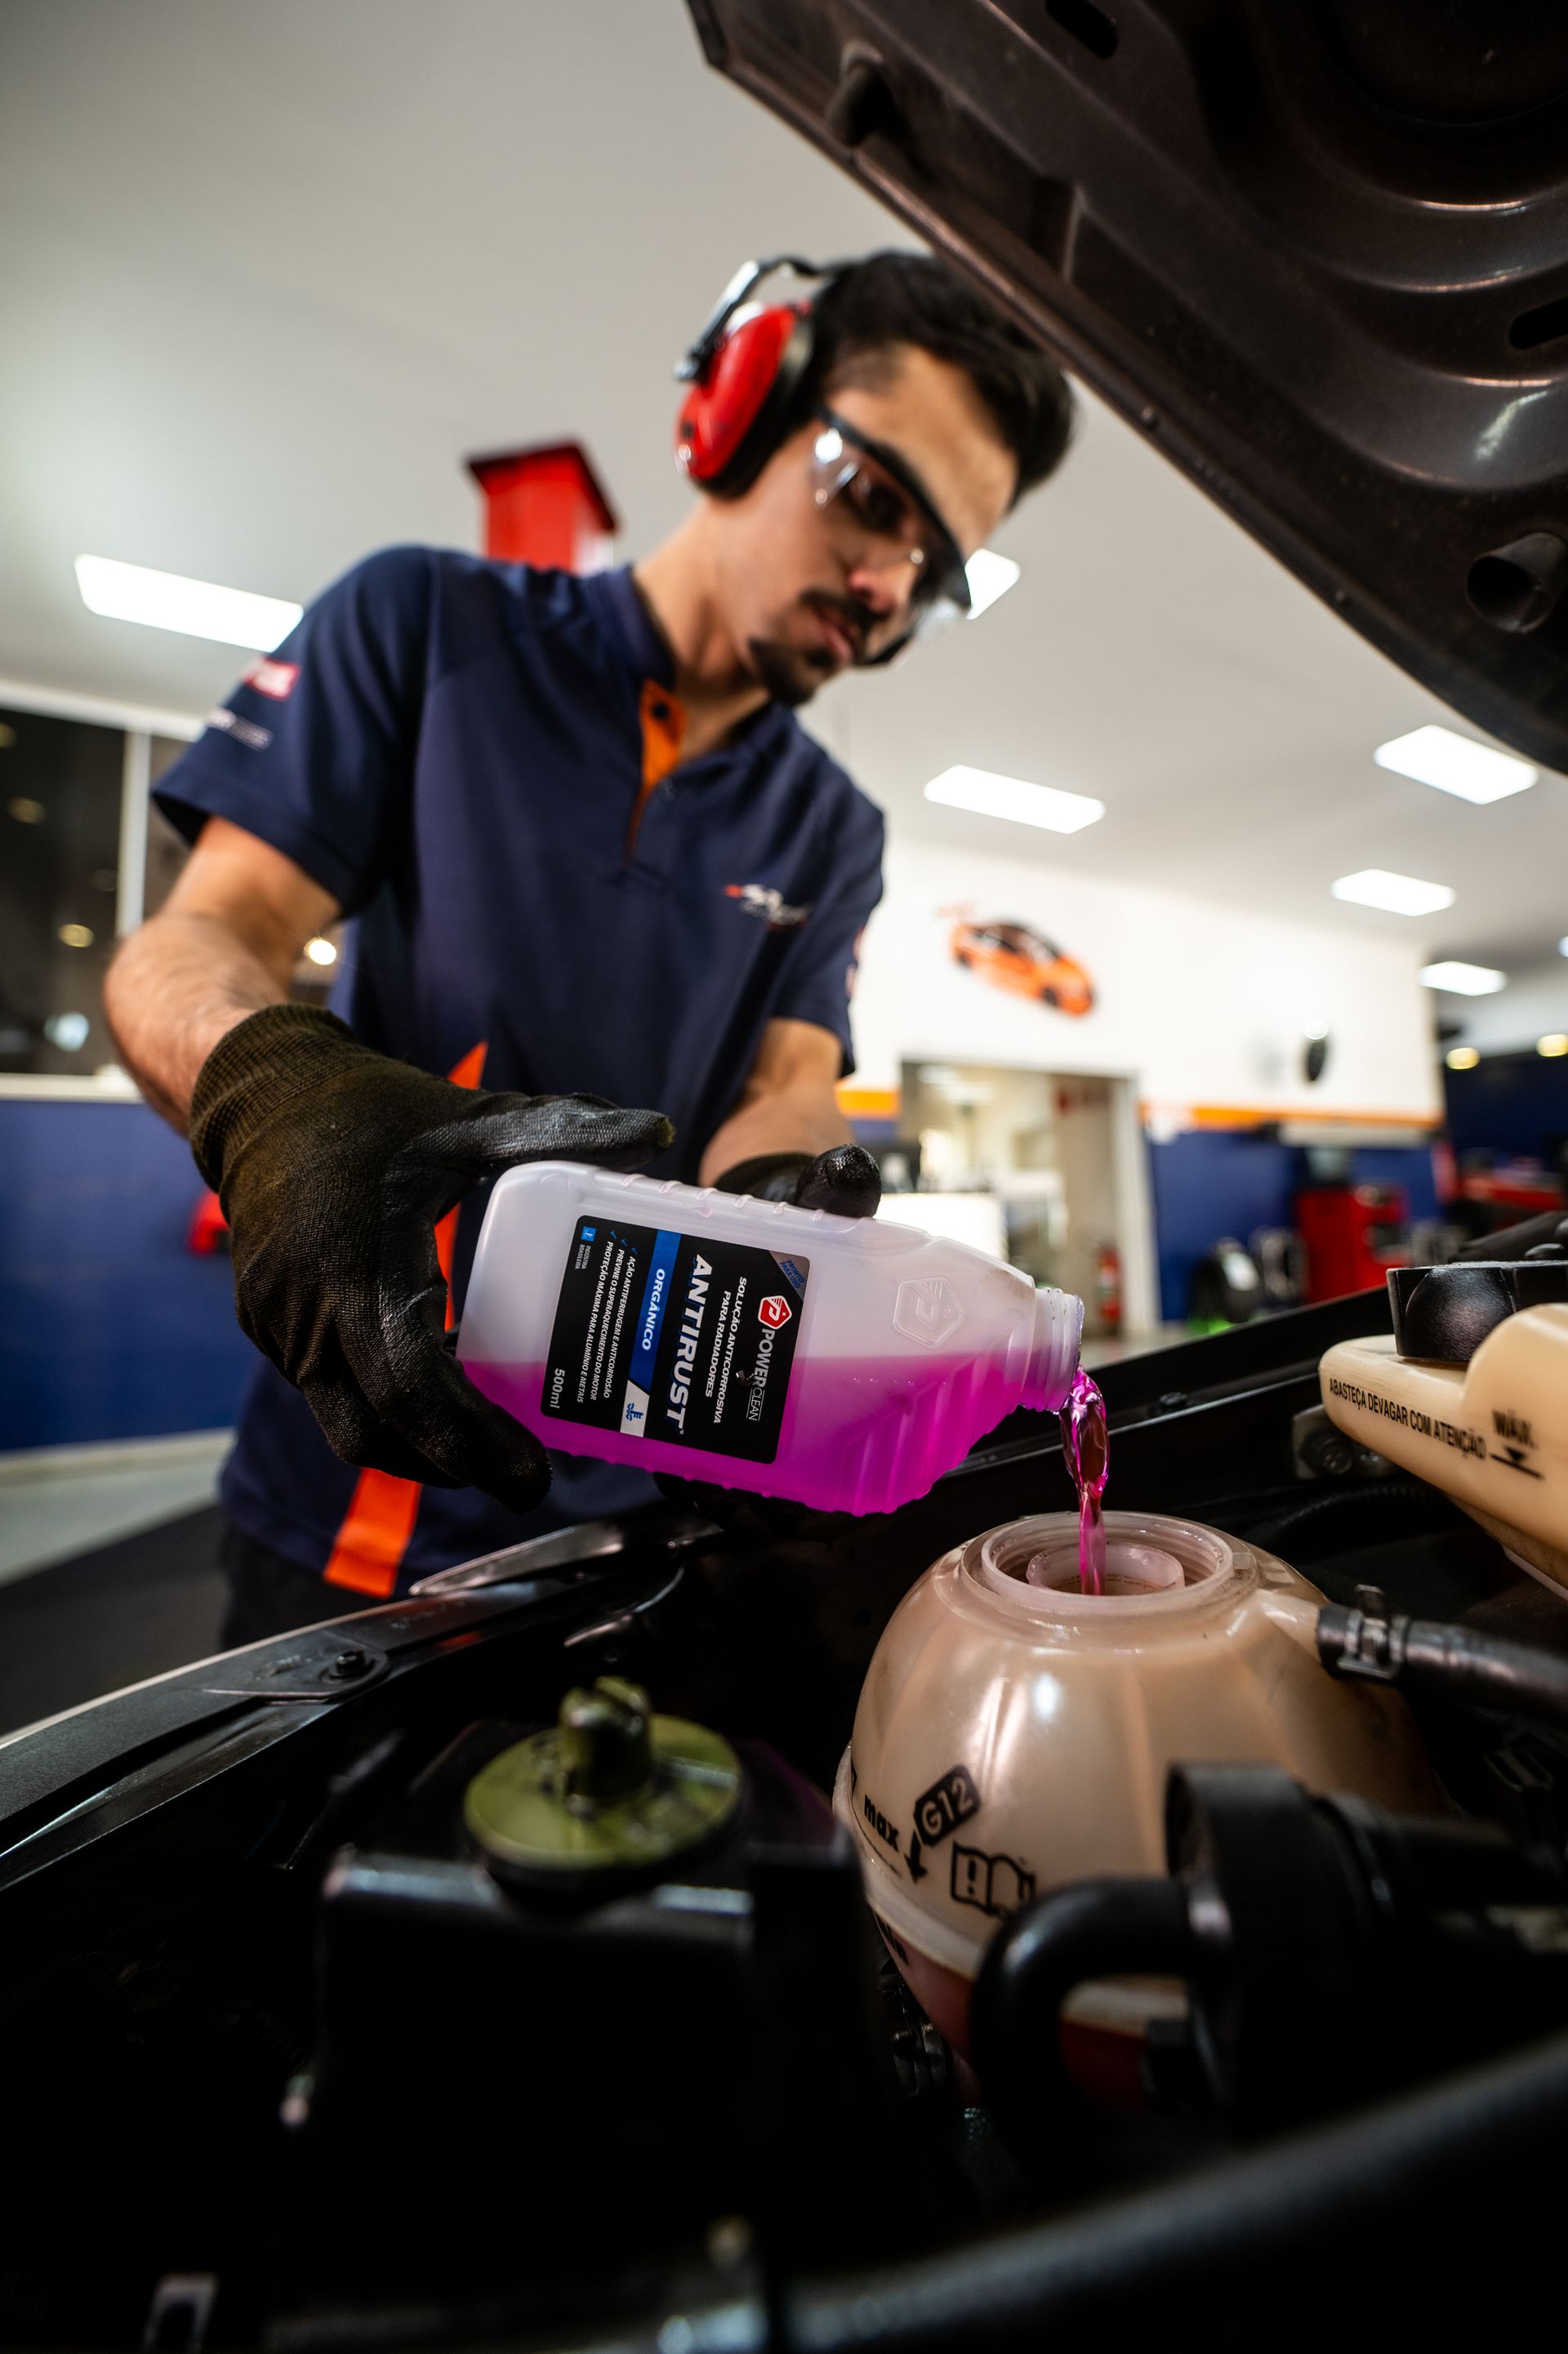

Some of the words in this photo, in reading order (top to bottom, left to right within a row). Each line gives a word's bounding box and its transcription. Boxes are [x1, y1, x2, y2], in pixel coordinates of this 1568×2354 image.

[574, 1244, 586, 1269] BRASILEIRA
[581, 1246, 591, 1269] INDÚSTRIA
[599, 1241, 614, 1281] PROTEÇÃO
[612, 1249, 625, 1281] PREVINE
[626, 1255, 636, 1277] AÇÃO
[591, 1281, 604, 1313] MÁXIMA
[613, 1277, 631, 1335] ANTIFERRUGEM
[642, 1268, 666, 1350] ORGÂNICO
[719, 1291, 731, 1322] PARA
[730, 1277, 747, 1332] SOLUÇÃO
[587, 1312, 598, 1333] PARA
[596, 1286, 617, 1362] SUPERAQUECIMENTO
[666, 1254, 713, 1429] ANTIRUST
[581, 1333, 594, 1371] ALUMÍNIO
[595, 1362, 602, 1374] DO
[603, 1341, 618, 1398] ANTICORROSÃO
[705, 1322, 725, 1398] RADIADORES
[550, 1368, 566, 1409] 500ml
[577, 1376, 587, 1403] METAIS
[590, 1373, 600, 1401] MOTOR
[713, 1332, 736, 1424] ANTICORROSIVA
[1330, 1378, 1367, 1411] ABASTEÇA
[1368, 1392, 1408, 1427] DEVAGAR
[1410, 1409, 1432, 1438] COM
[1432, 1419, 1486, 1460] ATENÇÃO
[864, 1793, 900, 1853] max
[920, 1776, 974, 1837] G12
